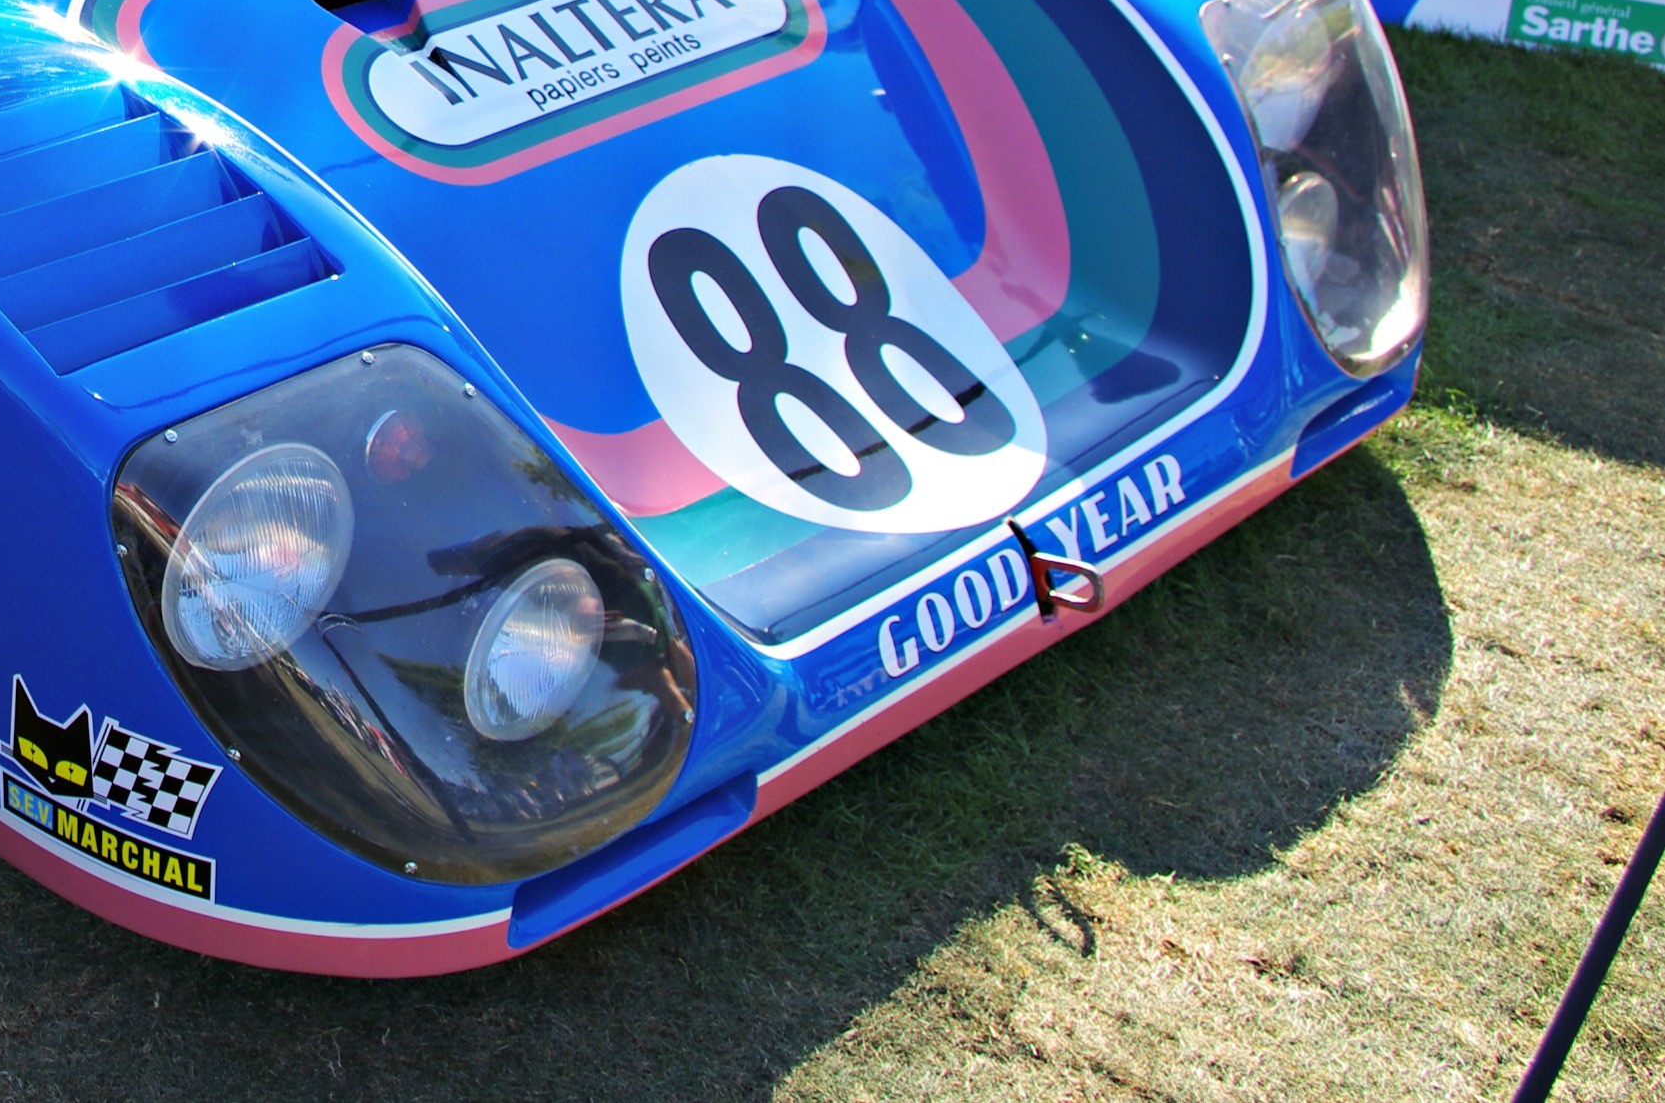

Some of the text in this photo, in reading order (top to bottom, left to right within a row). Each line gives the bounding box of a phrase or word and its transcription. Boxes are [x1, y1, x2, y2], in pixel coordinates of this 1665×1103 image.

[525, 31, 703, 111] papiers peints
[1520, 4, 1655, 55] Sarthe
[647, 185, 1018, 513] 88
[7, 784, 204, 894] S.E.V. MARCHAL
